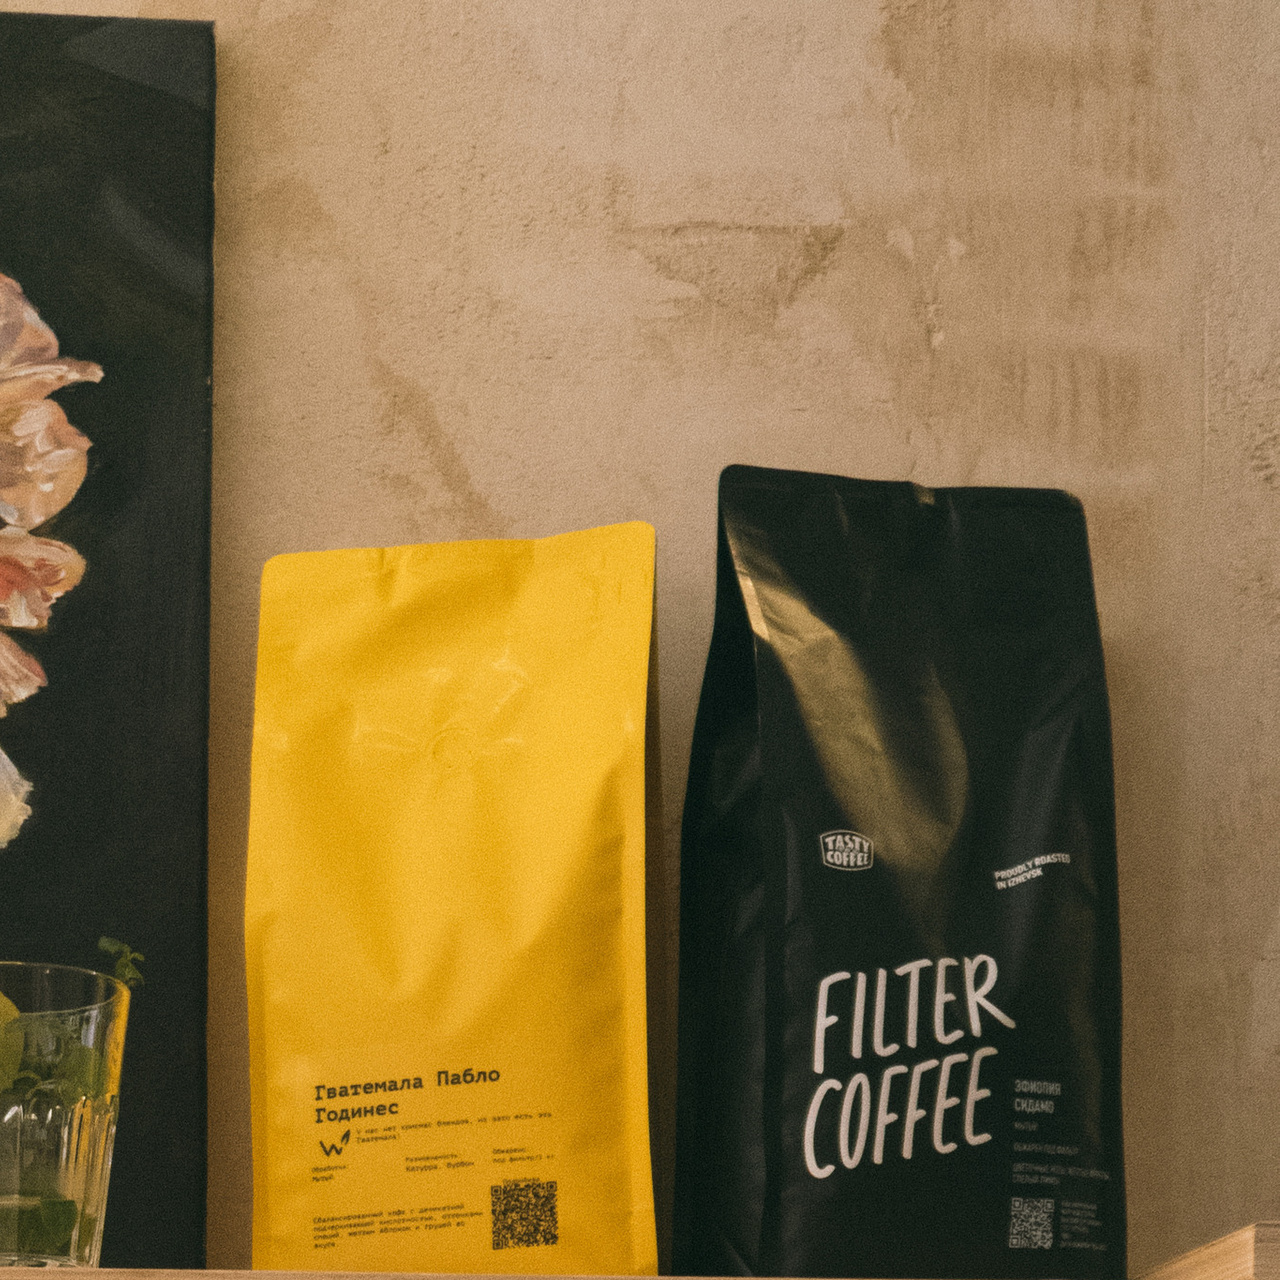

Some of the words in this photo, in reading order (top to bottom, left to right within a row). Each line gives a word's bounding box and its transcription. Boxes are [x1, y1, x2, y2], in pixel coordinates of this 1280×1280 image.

[825, 835, 870, 852] TASTY
[826, 850, 869, 866] COFFEE
[994, 860, 1033, 880] PROUDLY
[1034, 853, 1071, 867] ROASTED
[996, 880, 1007, 890] IN
[1007, 868, 1043, 887] IZHEVSK
[812, 954, 1017, 1075] FILTER
[314, 1077, 424, 1101] Гватемала
[437, 1067, 502, 1087] Пабло
[1014, 1080, 1062, 1096] ЭФИОПИЯ
[314, 1103, 399, 1124] Годинес
[803, 1046, 1000, 1179] COFFEE
